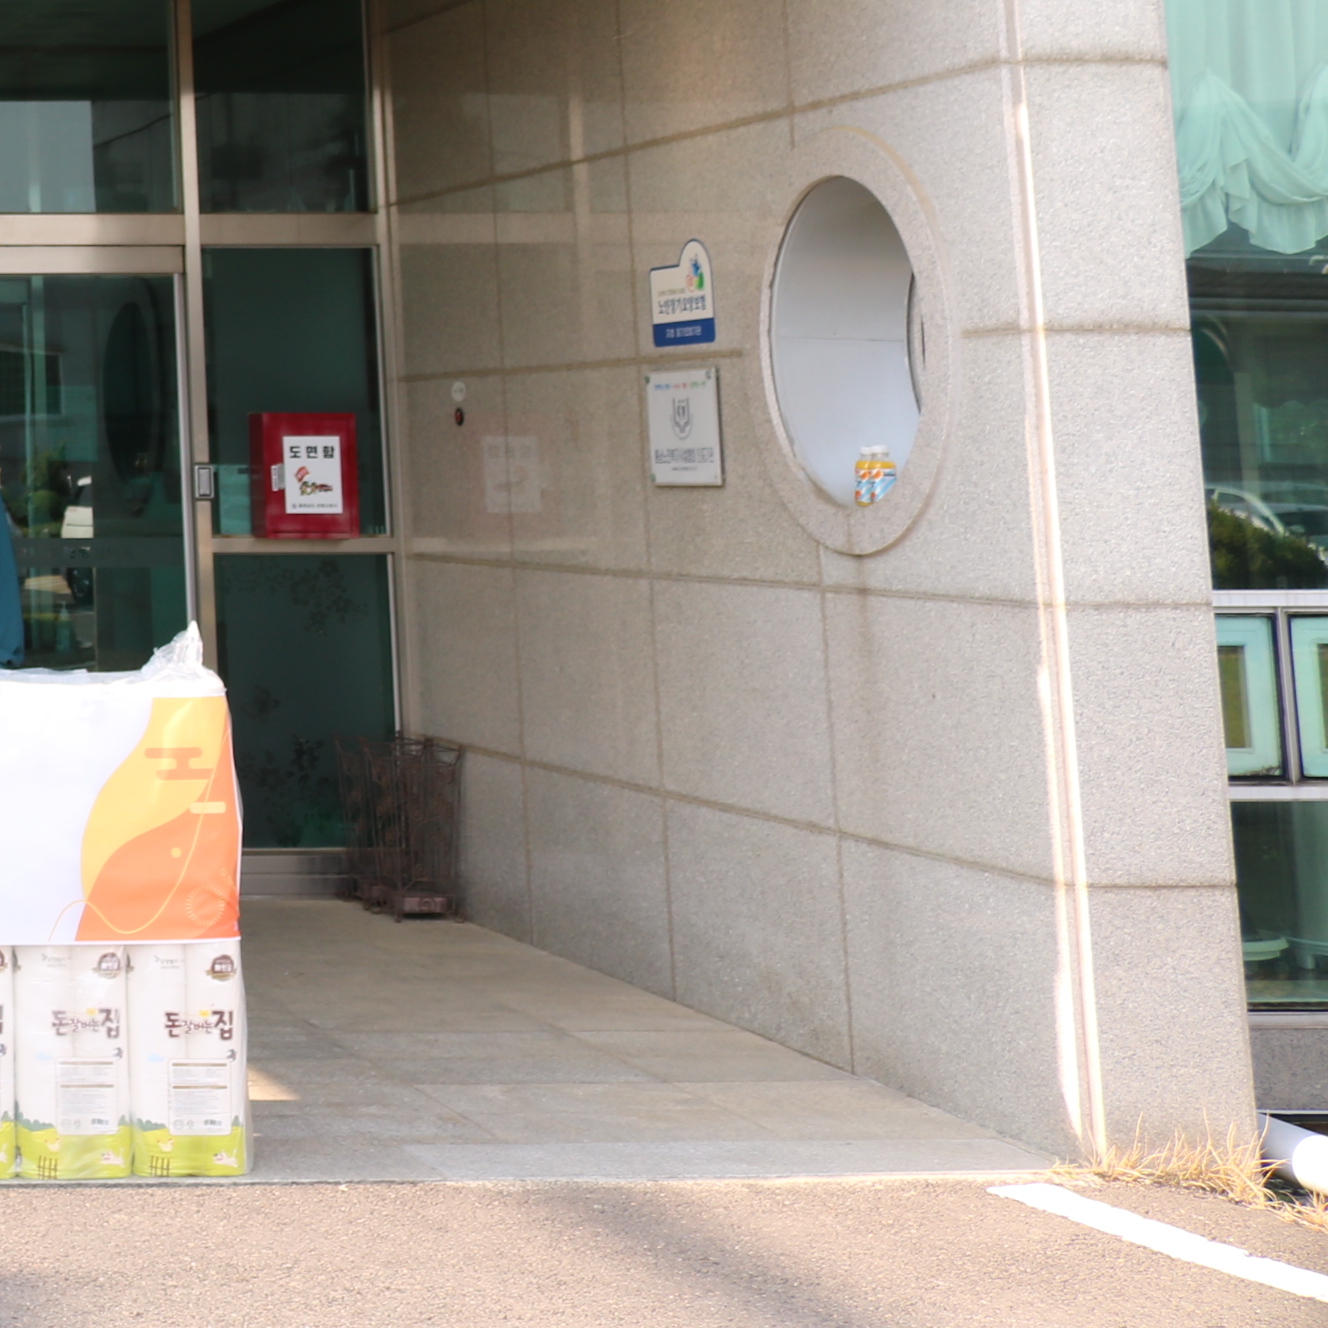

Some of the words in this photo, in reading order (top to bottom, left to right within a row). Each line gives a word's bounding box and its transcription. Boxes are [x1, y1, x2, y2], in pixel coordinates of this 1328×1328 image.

[52, 1011, 68, 1036] 돈
[99, 1009, 121, 1039] 집
[165, 1012, 181, 1038] 돈
[211, 1010, 234, 1041] 집
